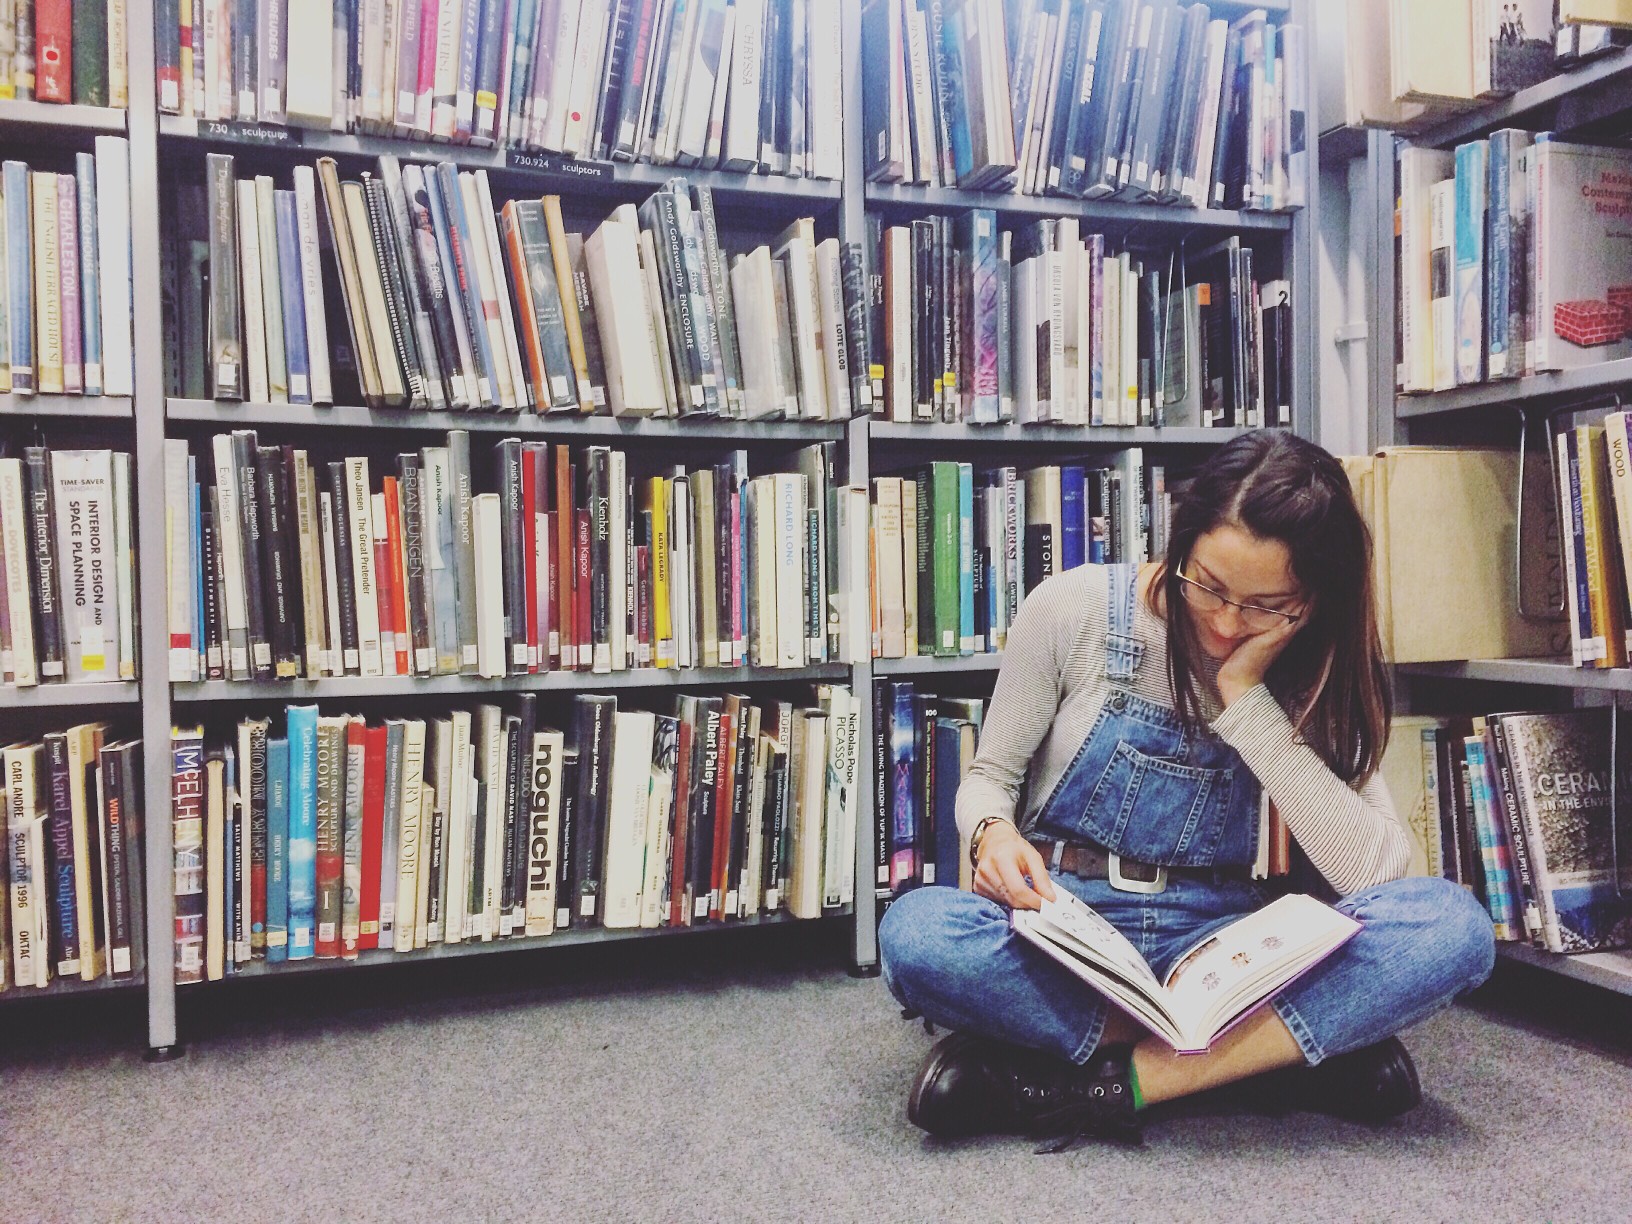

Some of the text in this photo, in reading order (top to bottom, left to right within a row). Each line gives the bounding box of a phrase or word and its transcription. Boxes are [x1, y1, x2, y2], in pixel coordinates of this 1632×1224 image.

[743, 24, 755, 86] CHRYSSA
[209, 123, 288, 140] 730 sculpture
[514, 156, 602, 176] 730.924 sculptors
[61, 198, 75, 297] CHARLESTON
[83, 237, 94, 275] HOUSE
[702, 191, 727, 320] Andy Goldsworthy STONE
[305, 259, 316, 296] vries
[431, 266, 444, 299] Breaths
[665, 200, 694, 350] Andy Goldsworthy ENCLOSURE
[697, 221, 718, 330] Andy Goldsworthy WALL
[697, 308, 710, 345] WOOD
[836, 323, 844, 347] LOTTE
[838, 349, 846, 371] GLOB
[1613, 438, 1626, 477] WOOD
[219, 466, 233, 522] Eva Hesse
[247, 467, 260, 540] Barbara Hepworth
[459, 473, 470, 544] Anish Kapoor
[509, 460, 520, 510] Anish Kapoor
[335, 475, 346, 547] CRISTINA IGLESIAS
[354, 462, 371, 595] Theo Jansen The Great Pretender
[404, 467, 422, 577] BRIAN JUNGEN
[598, 496, 609, 541] Kienholz
[785, 483, 794, 566] RICHARD LONG
[1008, 471, 1017, 559] BRICKWORKS
[1101, 476, 1111, 556] Sculptural Ceramics
[8, 530, 22, 593] DOVECOTES
[34, 489, 54, 613] The Interior Dimension
[70, 501, 86, 606] SPACE PLANNING
[88, 500, 103, 625] INTERIOR DESIGN AND
[216, 552, 224, 580] Hepworth
[579, 520, 589, 578] Anish Kapoor
[205, 528, 215, 624] BARBARA HEPWORTH
[812, 627, 819, 637] TO
[390, 744, 399, 762] Henry
[458, 724, 466, 739] Juan
[510, 731, 518, 741] THE
[705, 710, 720, 749] Albert
[738, 724, 747, 739] Paley
[835, 716, 847, 769] PICASSO
[846, 712, 858, 784] Nicholas Pope
[302, 727, 313, 826] Celebrating Moore
[347, 748, 360, 806] MOORE
[390, 763, 398, 781] Moore
[509, 742, 518, 772] SCULPTURE
[509, 774, 516, 783] OF
[521, 754, 532, 797] NILS-UDO
[591, 765, 599, 796] Anthology
[593, 756, 600, 764] An
[702, 751, 718, 786] Paley
[1507, 724, 1519, 761] CERAMICS
[1519, 785, 1534, 836] ENVIRONMENT
[317, 728, 330, 852] HENRY MOORE
[330, 778, 338, 793] AND
[401, 742, 422, 880] HENRY MOORE
[509, 784, 517, 804] DAVID
[1559, 797, 1581, 810] THE
[11, 761, 28, 908] CARL ANDRE SCULPTOR 1996
[508, 805, 516, 824] NASH
[530, 744, 553, 891] noguchi
[879, 808, 885, 817] OF
[1500, 767, 1531, 886] Making CERAMIC SCULPTURE
[52, 741, 77, 939] Kuspit Karel Appel Sculpture
[505, 849, 513, 877] ANDREWS
